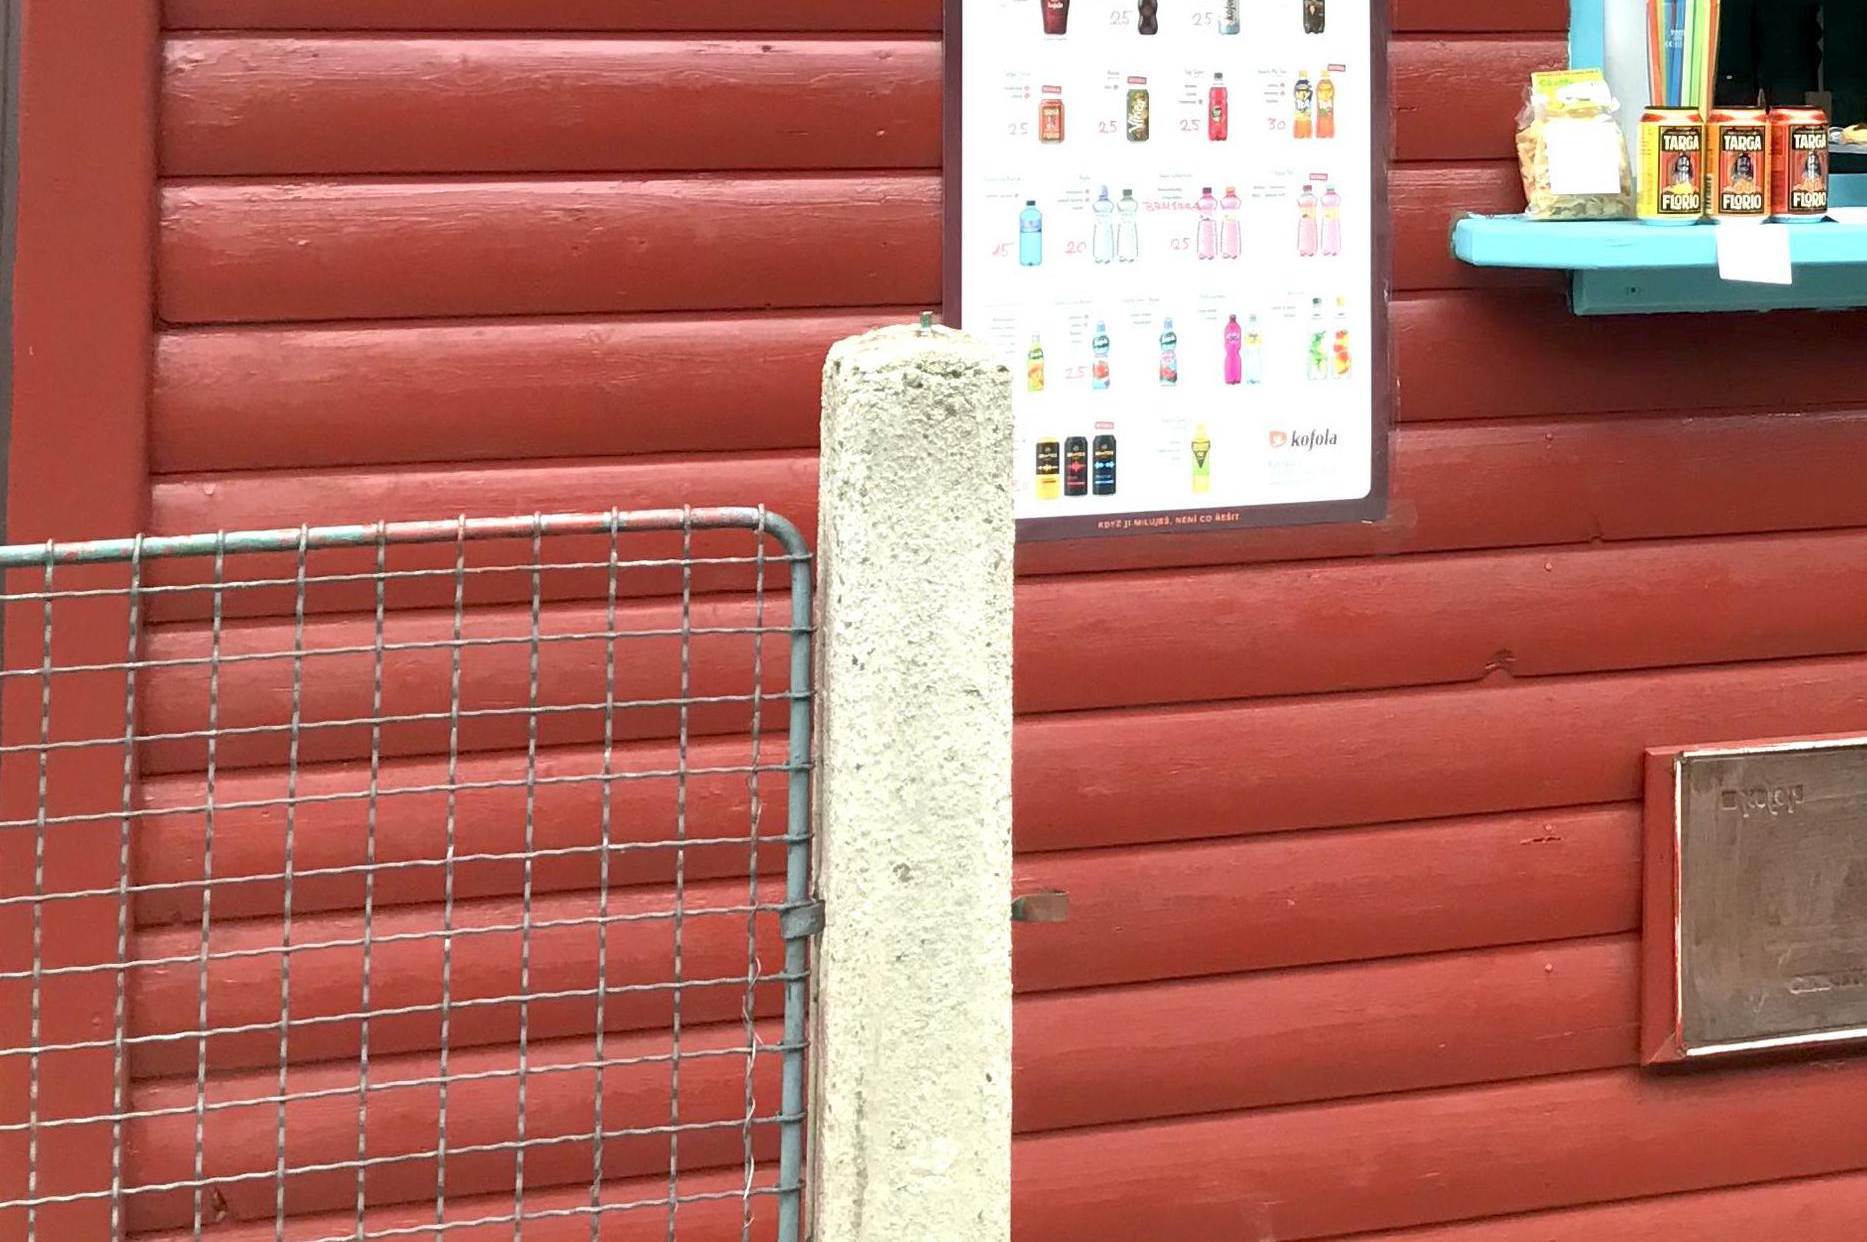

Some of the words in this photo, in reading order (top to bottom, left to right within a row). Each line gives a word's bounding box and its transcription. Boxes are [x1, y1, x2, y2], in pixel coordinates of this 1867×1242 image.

[1191, 11, 1213, 27] 25
[1008, 122, 1029, 135] 25
[1098, 120, 1118, 135] 25
[1179, 118, 1200, 132] 25
[1664, 134, 1699, 151] TARGA
[1723, 134, 1762, 151] TARGA
[1793, 134, 1826, 149] TARGA
[1662, 193, 1699, 211] FLORIO
[1723, 193, 1762, 211] FLORIO
[1792, 191, 1826, 209] FLORIO
[1291, 428, 1338, 451] kofola
[1199, 515, 1212, 523] CO
